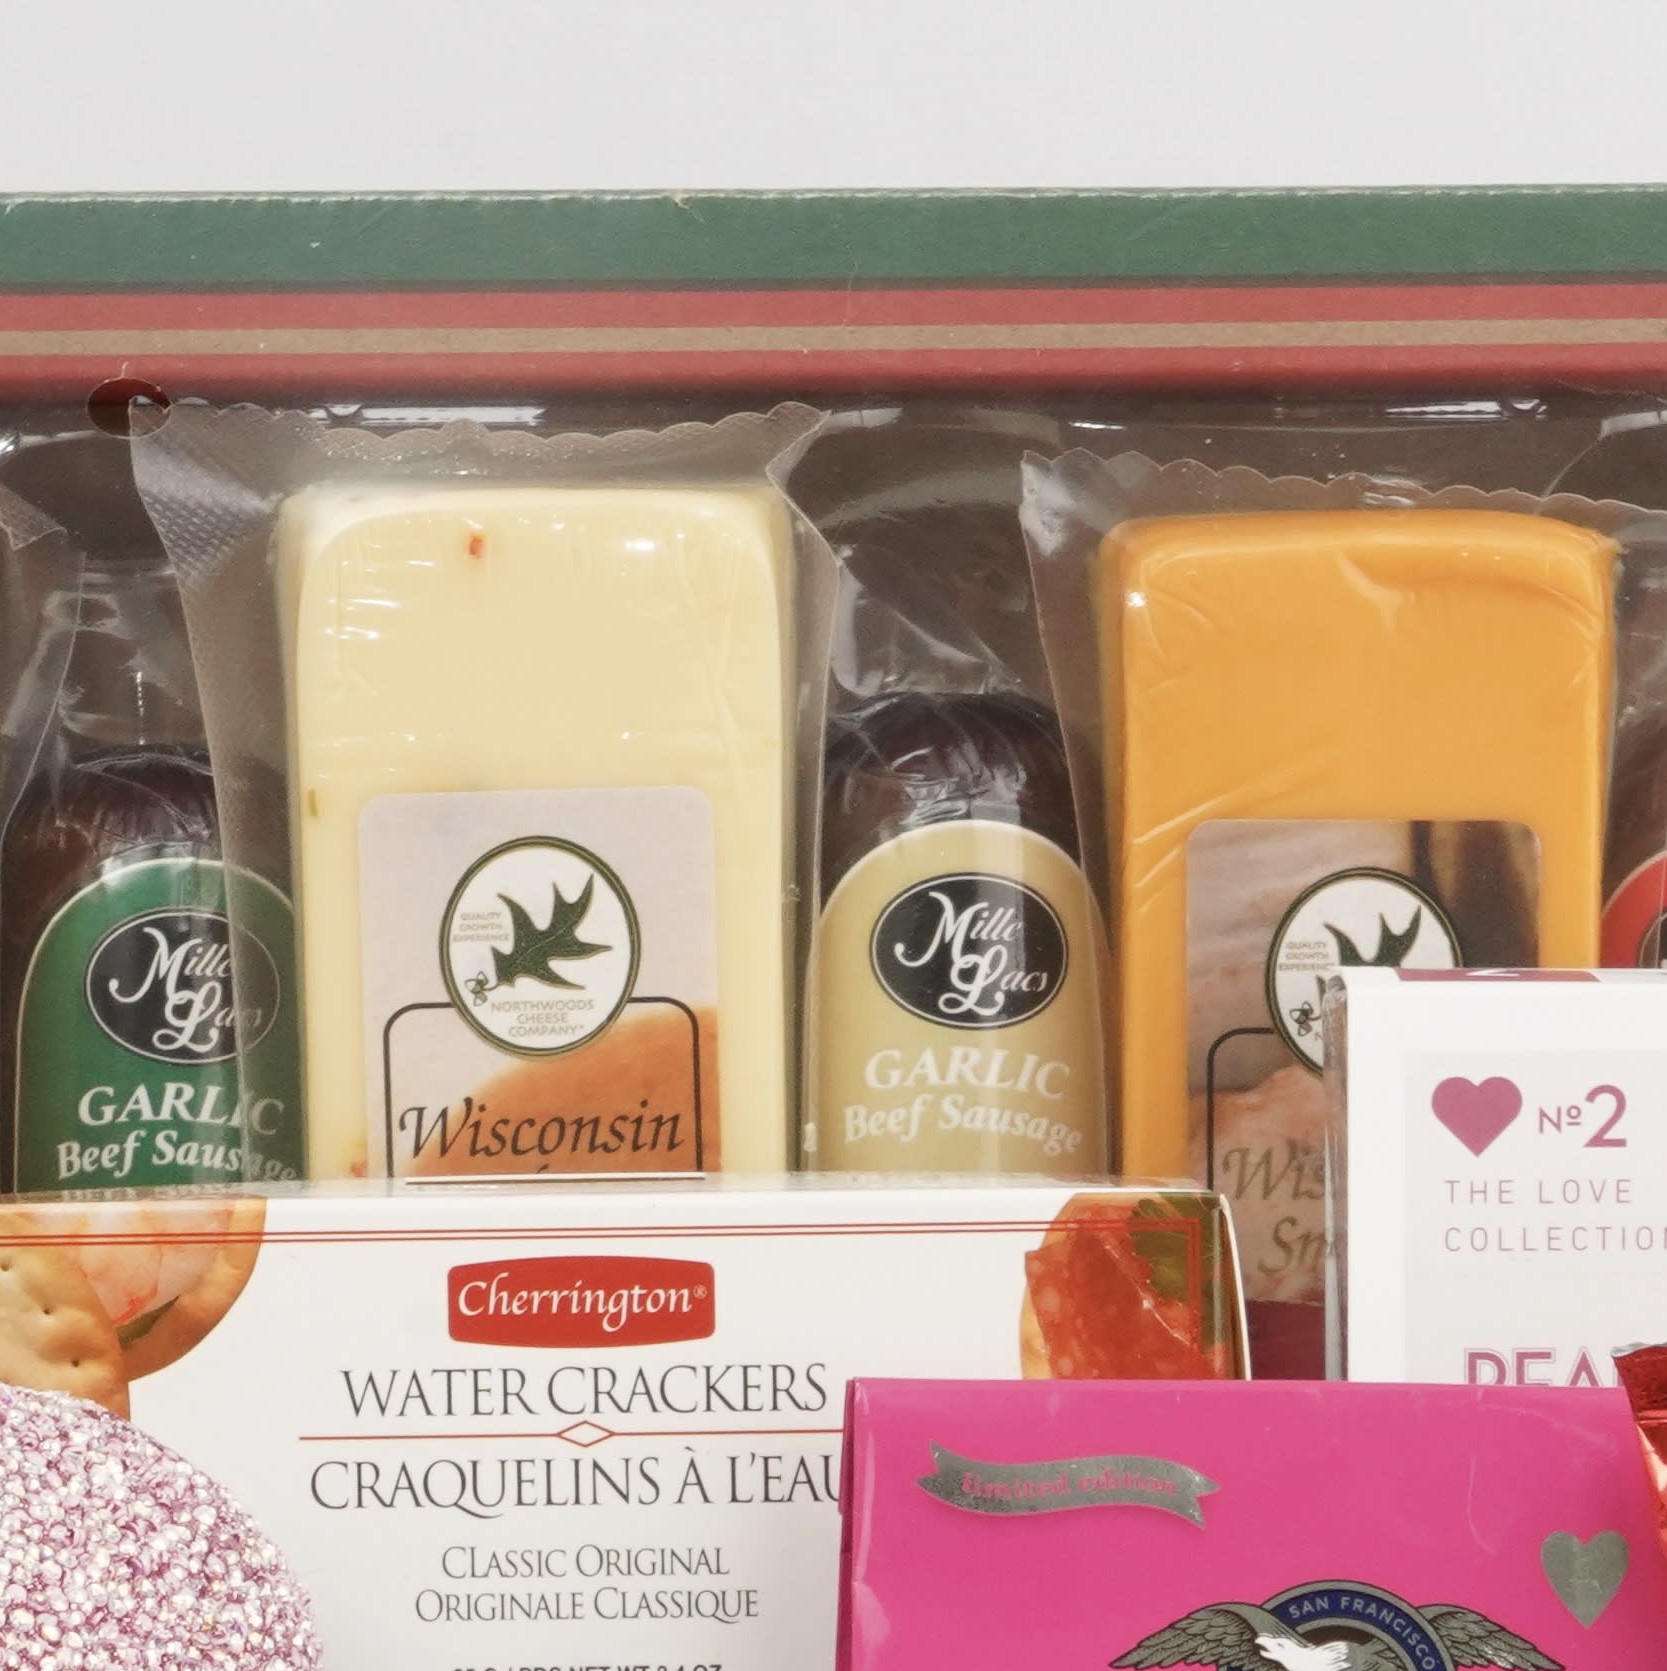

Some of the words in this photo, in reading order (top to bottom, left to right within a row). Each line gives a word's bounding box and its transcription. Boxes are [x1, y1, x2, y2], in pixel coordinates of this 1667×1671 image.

[453, 933, 509, 943] EXPERIENCE
[459, 922, 503, 932] GROWTH
[460, 911, 502, 921] QUALITY
[894, 892, 1024, 967] Mille
[938, 945, 1048, 1016] Lacs
[491, 999, 595, 1014] NORTHWOODS
[516, 1013, 569, 1025] CHEESE
[864, 1046, 1071, 1100] GARLIC
[399, 1097, 686, 1160] Wisconsin
[845, 1095, 931, 1144] Beef
[938, 1095, 1082, 1158] Sausage
[1444, 1179, 1514, 1206] THE
[1537, 1179, 1633, 1206] LOVE
[340, 1367, 536, 1417] WATER
[547, 1362, 828, 1415] CRACKERS
[310, 1457, 660, 1519] CRAQUELINS
[677, 1446, 713, 1504] À
[442, 1545, 567, 1579] CLASSIC
[576, 1543, 730, 1578] ORIGINAL
[415, 1588, 585, 1622] ORIGINALE
[593, 1586, 760, 1625] CLASSIQUE
[1288, 1595, 1329, 1620] SAN
[1341, 1596, 1437, 1671] FRANCISCO
